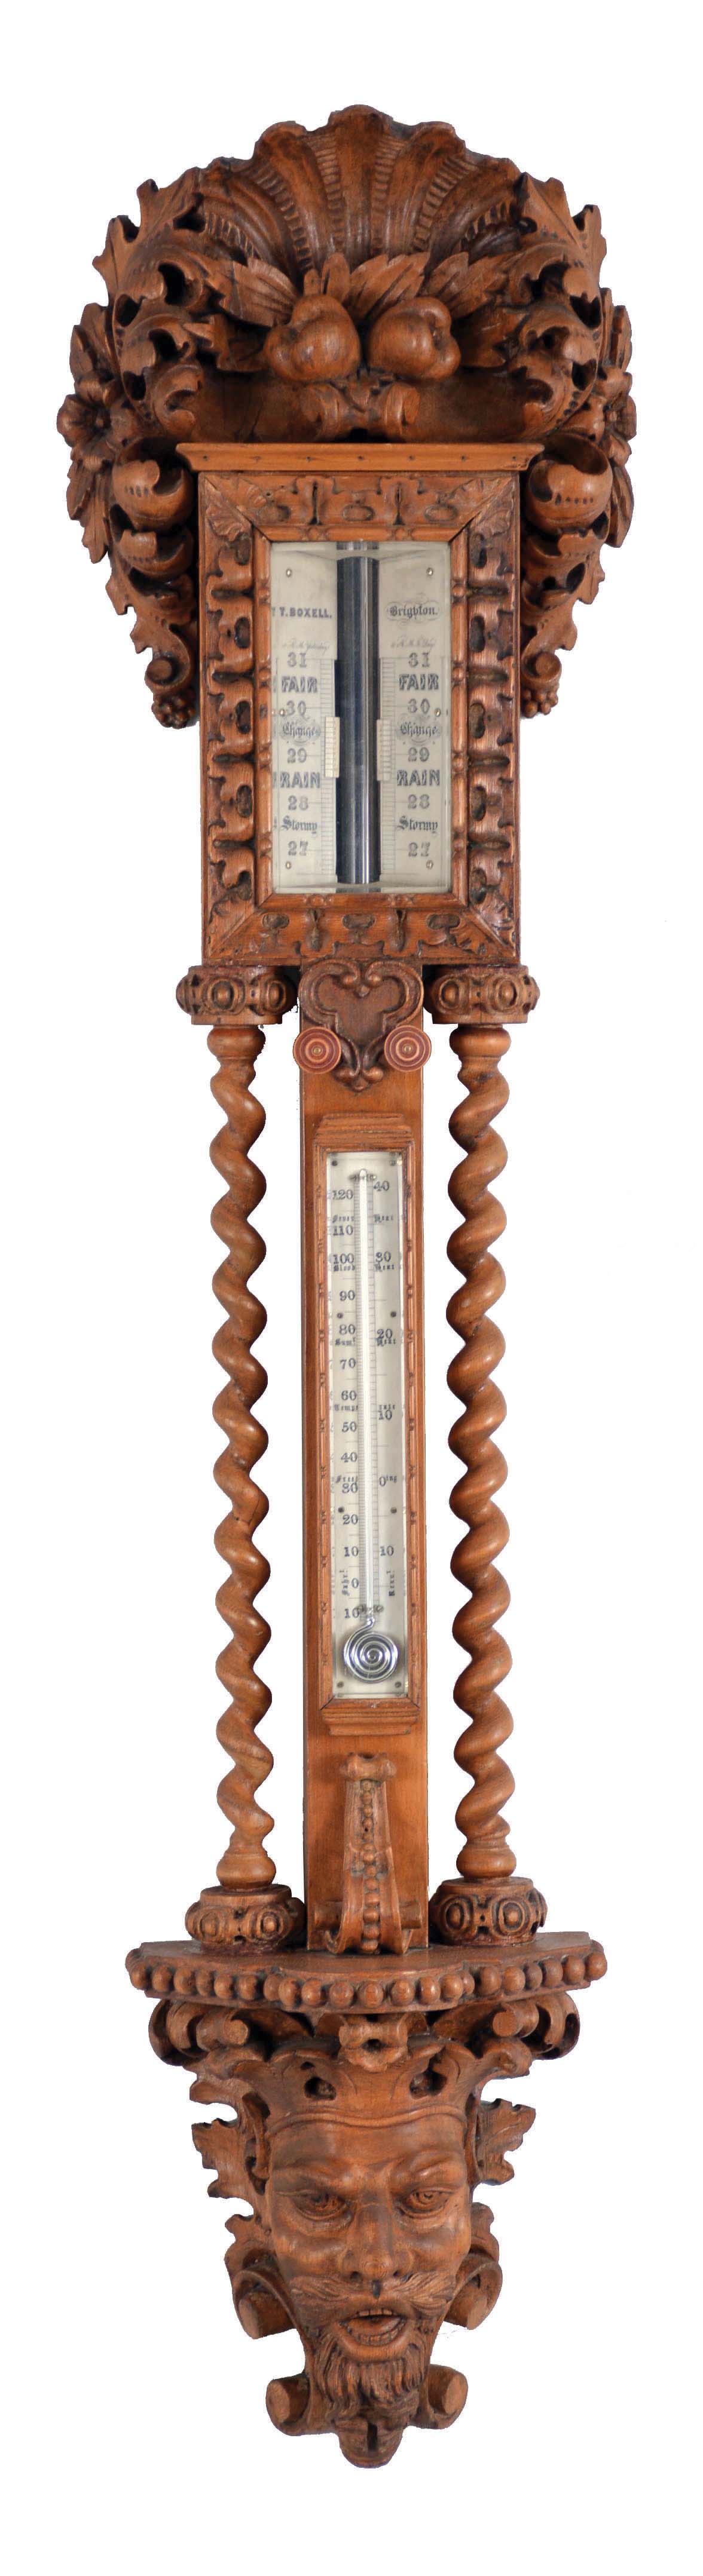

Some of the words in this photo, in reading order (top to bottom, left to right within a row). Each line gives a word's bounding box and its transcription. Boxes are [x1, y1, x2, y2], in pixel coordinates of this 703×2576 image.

[288, 652, 307, 667] 31
[408, 652, 430, 667] 31
[281, 676, 318, 693] FAIR
[399, 673, 439, 691] FAIR
[286, 700, 306, 716] 30
[408, 698, 430, 714] 30
[287, 748, 307, 763] 29
[408, 747, 430, 762] 29
[280, 772, 320, 789] RAIN
[397, 769, 440, 786] RAIN
[288, 795, 308, 810] 28
[408, 794, 430, 809] 28
[281, 815, 318, 834] Stormy
[397, 815, 438, 834] Stormy
[288, 841, 308, 856] 27
[408, 842, 430, 857] 27
[374, 1180, 389, 1192] 40
[332, 1189, 353, 1200] 120
[333, 1225, 353, 1236] 110
[333, 1253, 354, 1264] 100
[375, 1251, 392, 1262] 30
[340, 1290, 355, 1301] 90
[339, 1324, 356, 1335] 80
[377, 1329, 393, 1339] 20
[340, 1358, 356, 1369] 70
[341, 1390, 357, 1401] 60
[378, 1410, 392, 1420] 10
[342, 1421, 356, 1432] 50
[341, 1452, 357, 1463] 40
[342, 1482, 358, 1493] 30
[343, 1514, 358, 1525] 20
[344, 1546, 359, 1556] 10
[380, 1545, 395, 1556] 10
[352, 1578, 359, 1588] 0
[345, 1608, 359, 1618] 10
